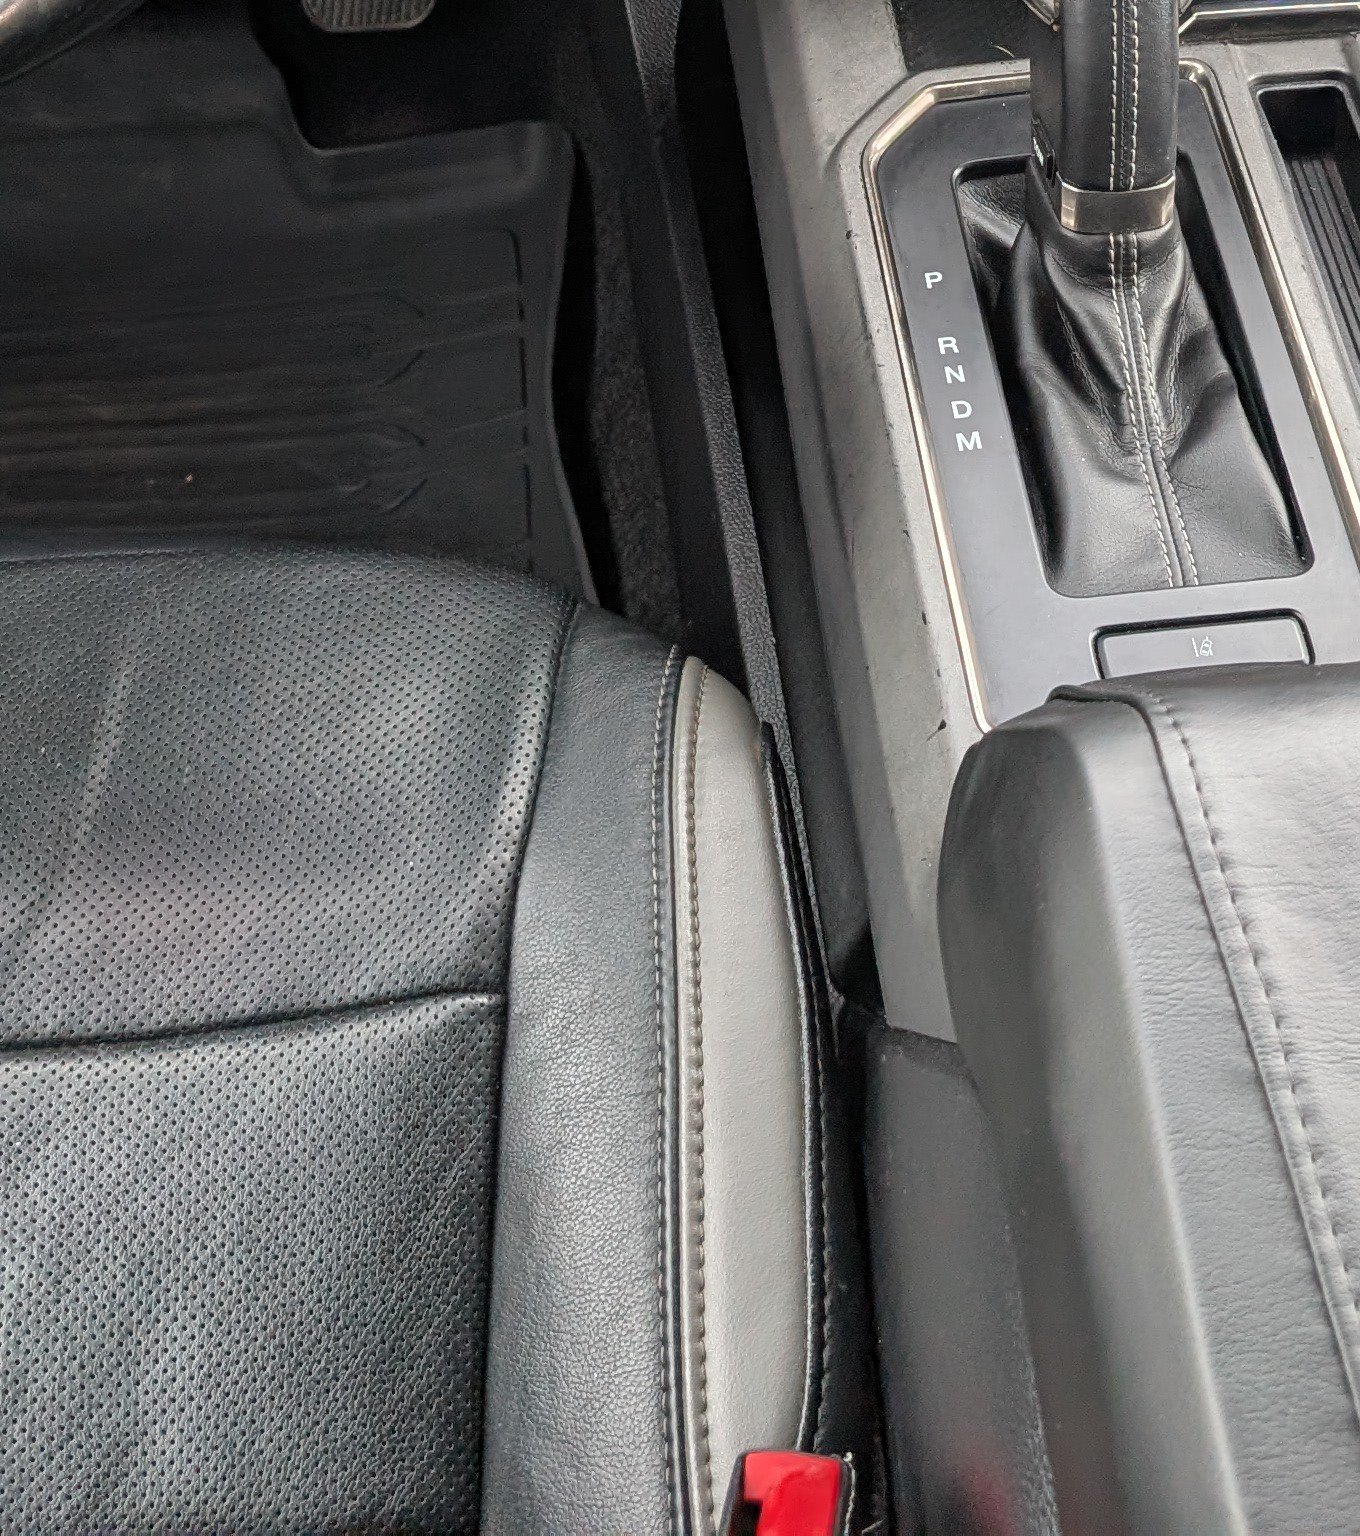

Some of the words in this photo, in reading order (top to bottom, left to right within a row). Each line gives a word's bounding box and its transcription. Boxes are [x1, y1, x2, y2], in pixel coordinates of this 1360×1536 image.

[924, 271, 943, 290] P
[937, 336, 960, 355] R
[943, 364, 966, 384] N
[950, 399, 973, 419] D
[955, 430, 983, 452] M
